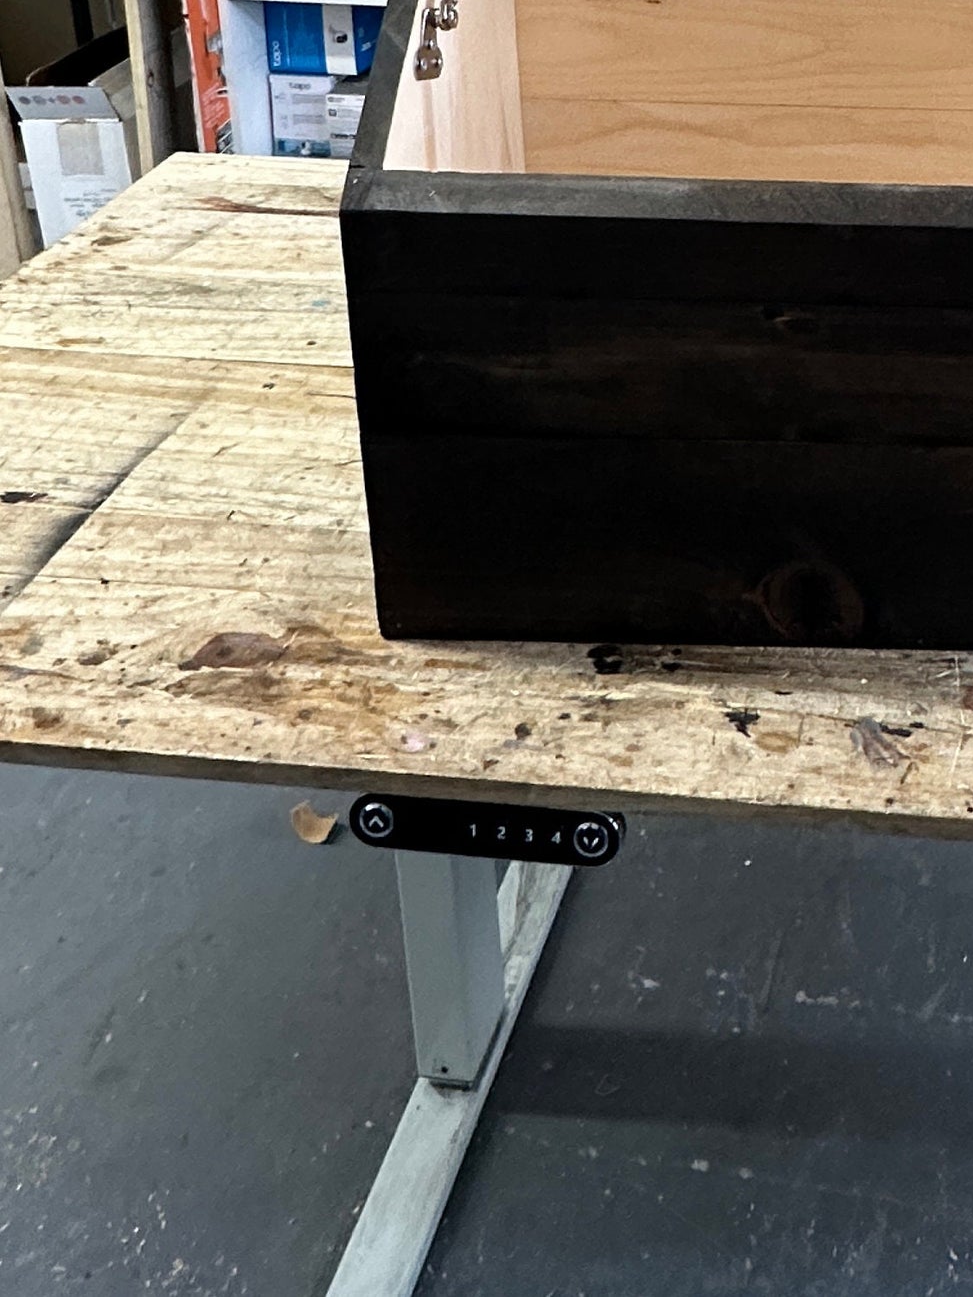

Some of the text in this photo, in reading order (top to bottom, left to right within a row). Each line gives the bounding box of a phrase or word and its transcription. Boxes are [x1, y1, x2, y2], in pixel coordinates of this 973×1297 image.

[272, 40, 282, 67] tapo
[469, 823, 561, 844] 1 2 3 4
